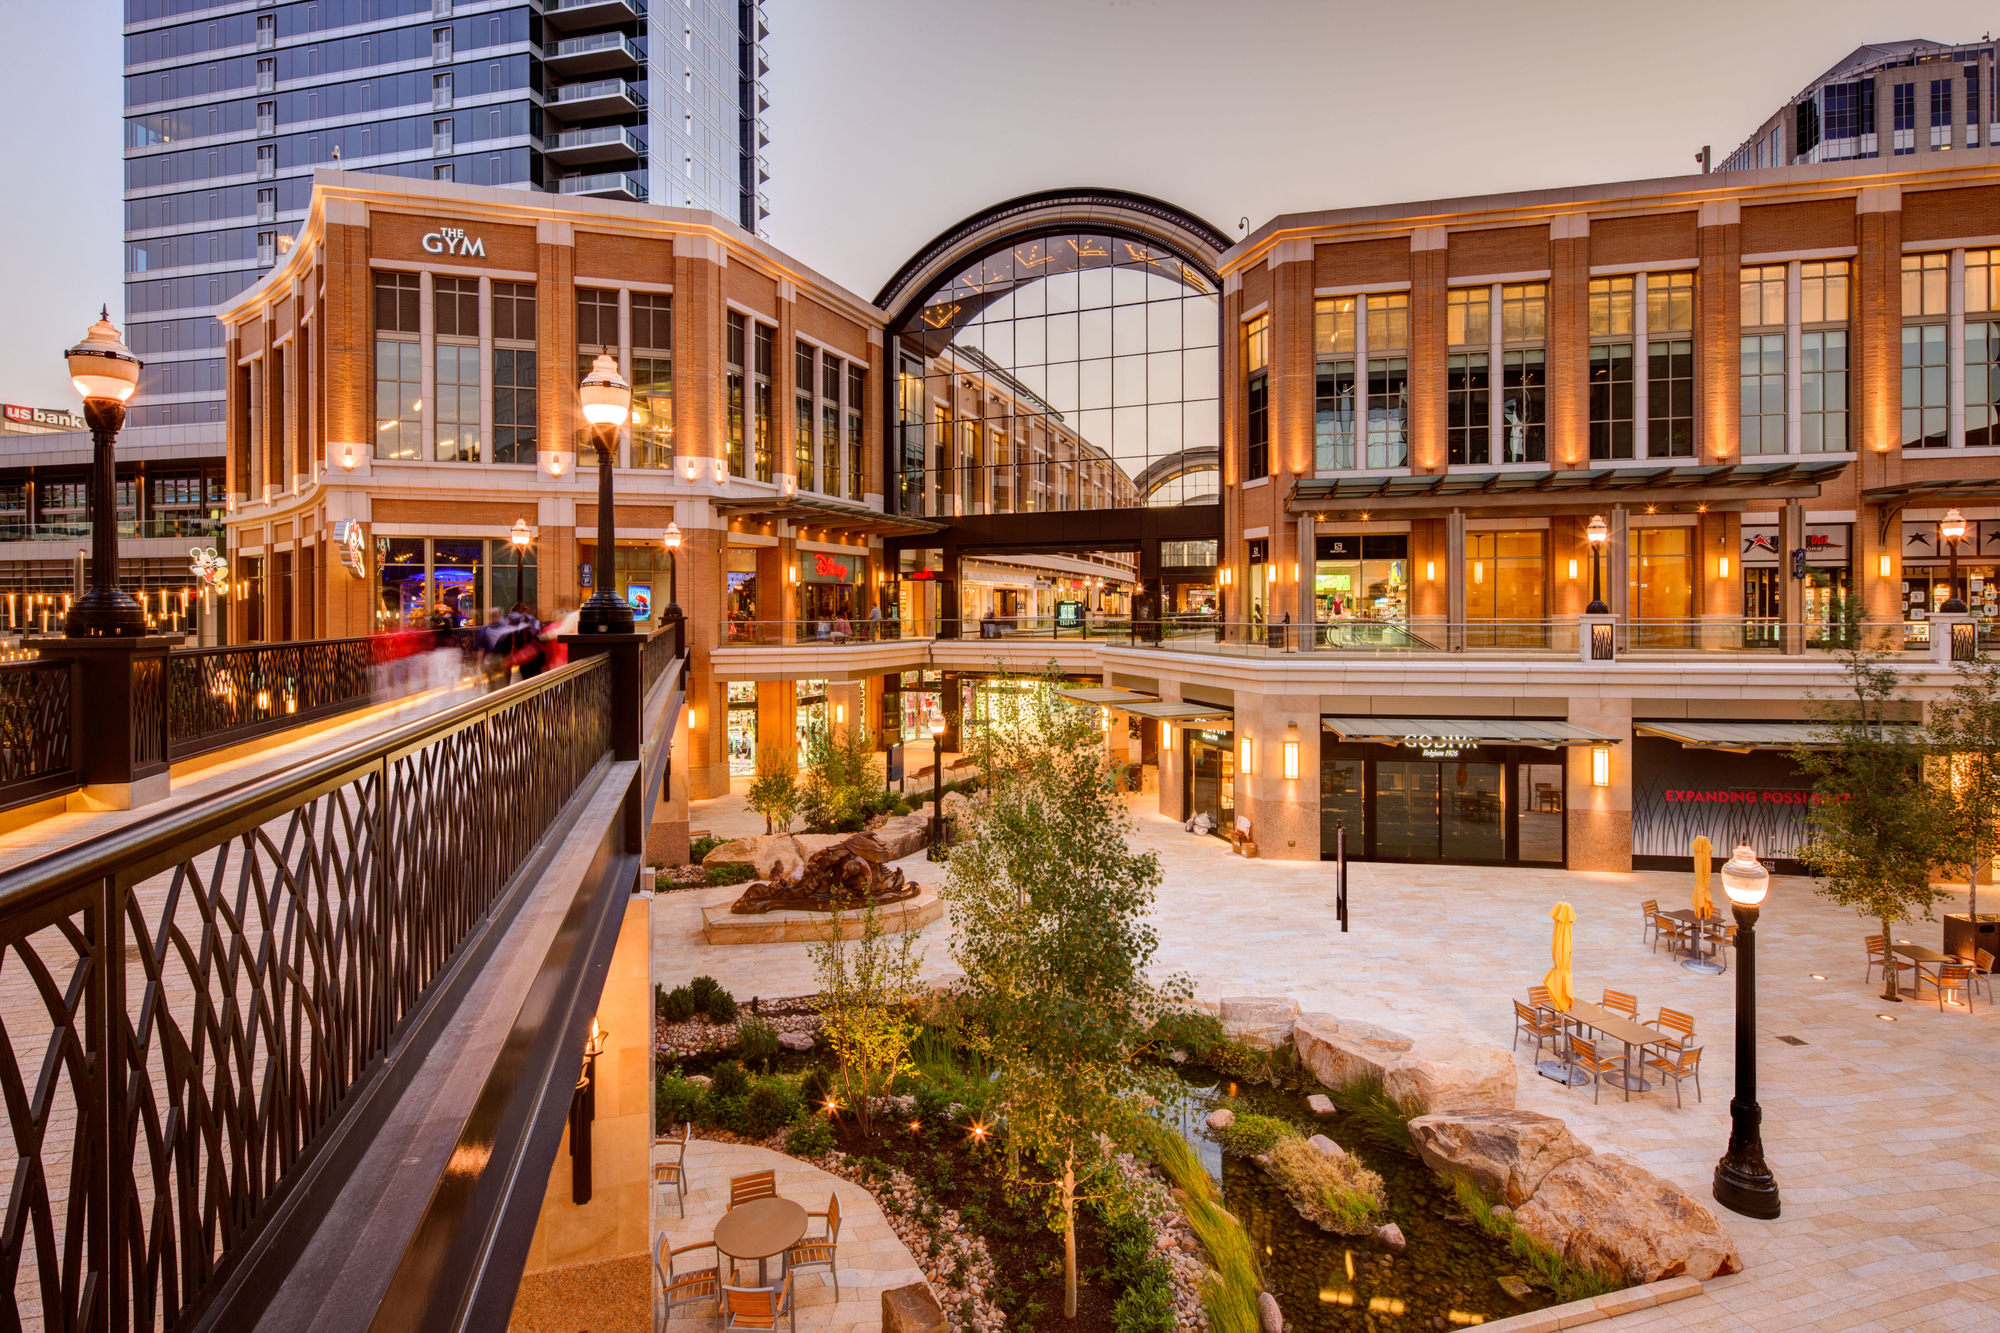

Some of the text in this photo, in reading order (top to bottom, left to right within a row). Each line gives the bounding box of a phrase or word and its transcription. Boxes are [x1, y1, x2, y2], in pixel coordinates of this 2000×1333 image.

[440, 227, 464, 238] THE
[422, 232, 486, 258] GYM
[1666, 789, 1757, 803] EXPANDING
